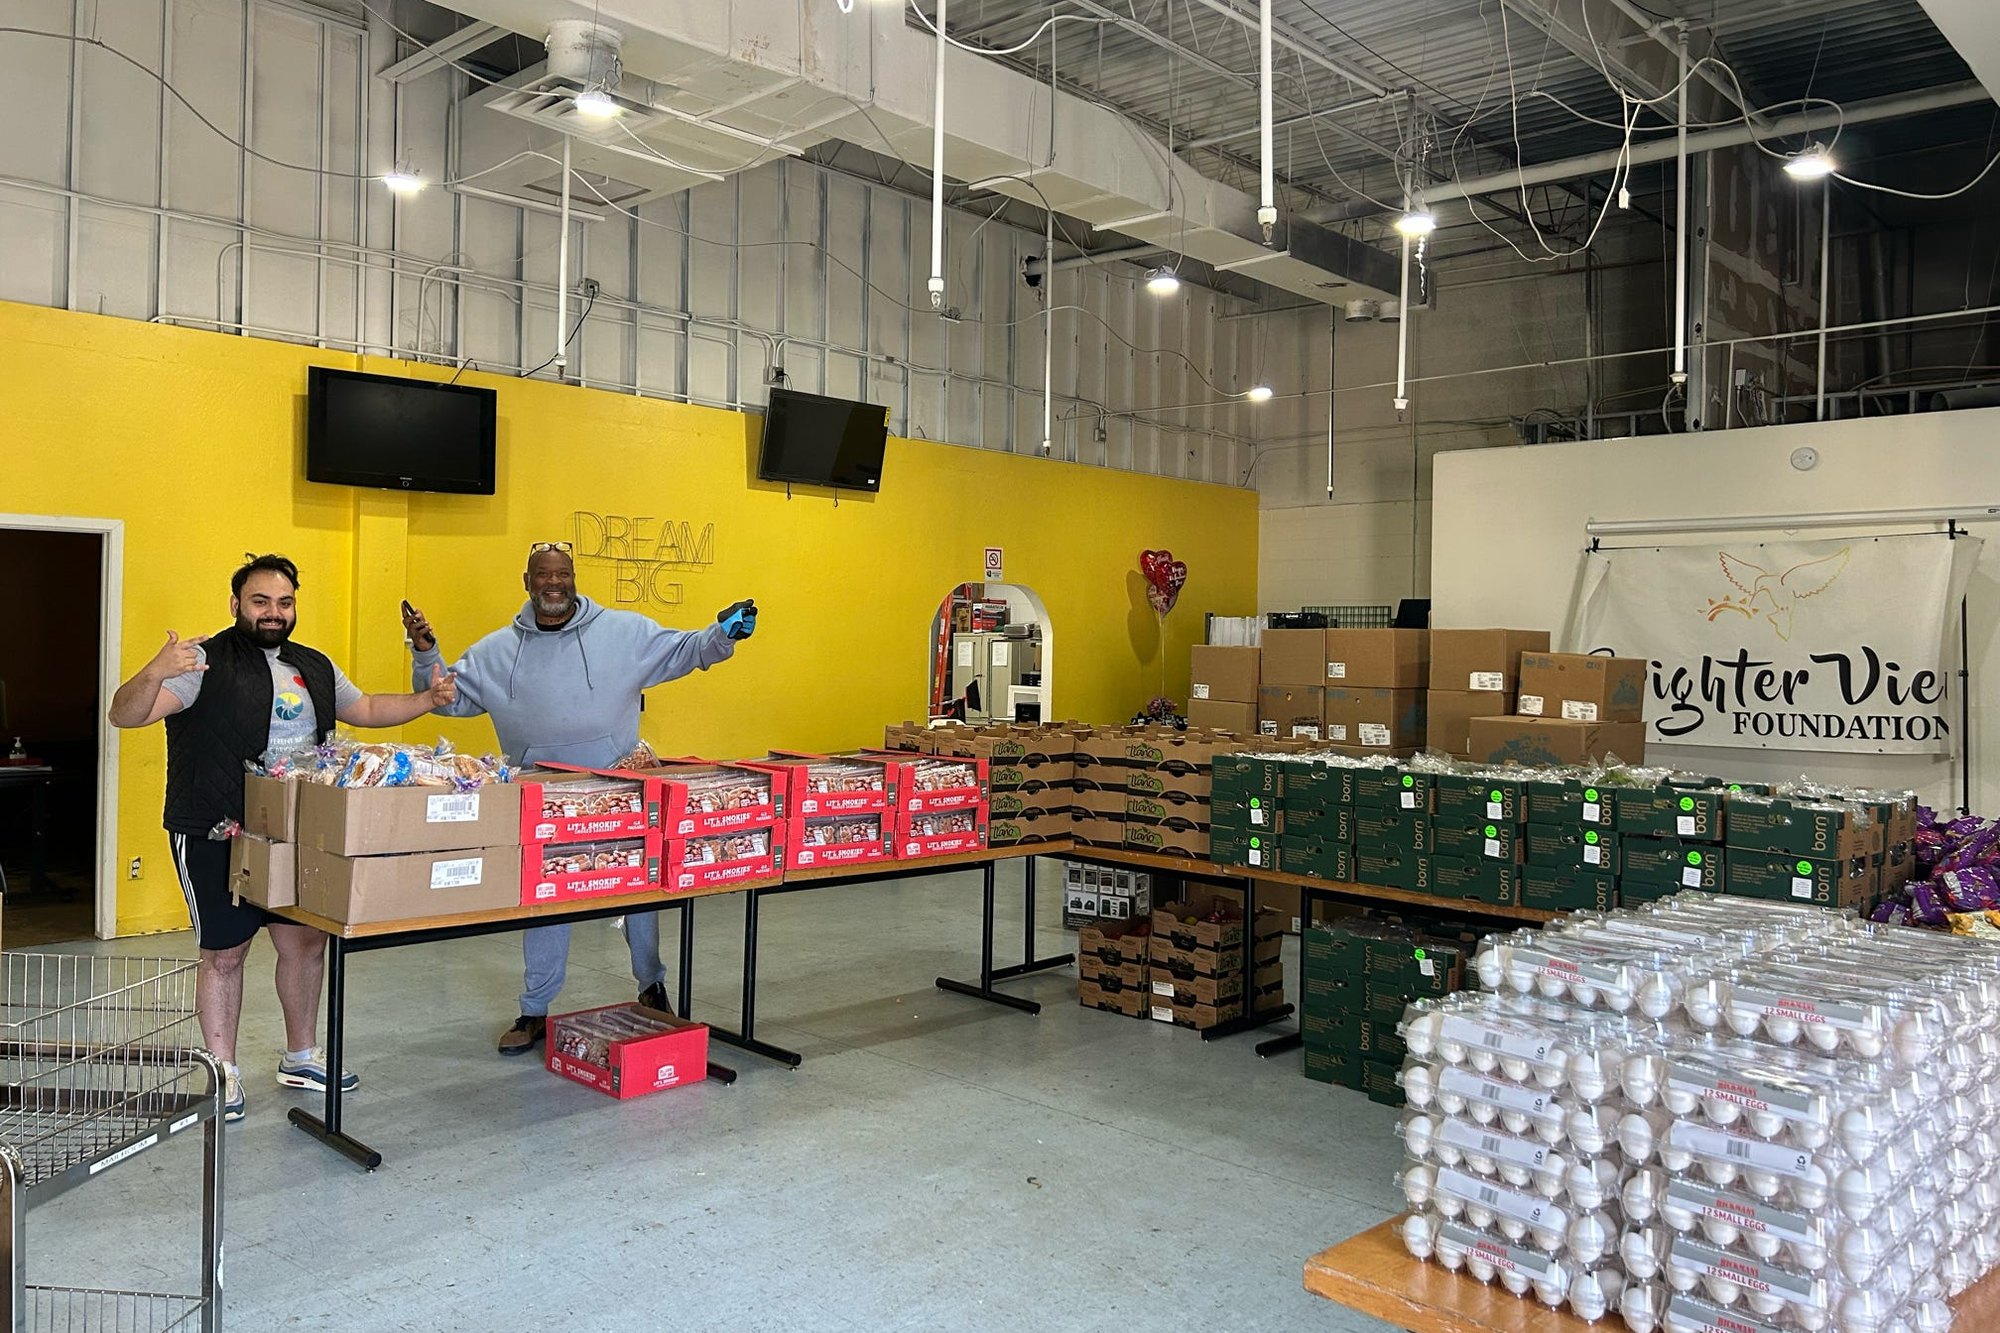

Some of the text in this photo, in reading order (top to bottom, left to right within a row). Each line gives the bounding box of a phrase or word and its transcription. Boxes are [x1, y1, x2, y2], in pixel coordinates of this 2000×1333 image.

[575, 511, 714, 564] DREAM
[616, 559, 683, 604] BIG
[1588, 646, 1948, 737] ighter Vie
[1263, 764, 1274, 791] born
[1341, 774, 1352, 802] born
[1502, 787, 1513, 818] born
[1600, 794, 1612, 826] born
[1695, 800, 1709, 834] born
[1337, 811, 1348, 840] born
[1413, 820, 1424, 850] born
[1811, 815, 1828, 851] born
[1261, 841, 1271, 868] born
[1499, 829, 1510, 859] born
[1599, 837, 1612, 869] born
[1336, 851, 1347, 879] born
[1416, 858, 1428, 888] born
[1702, 853, 1718, 887] born
[1498, 869, 1510, 901] born
[1815, 867, 1831, 902] born
[1431, 960, 1443, 990] born
[1538, 966, 1586, 984] 12 SMALL EGGS
[1765, 1006, 1826, 1024] 12 SMALL EGGS
[1359, 1022, 1371, 1052] born
[1703, 1088, 1769, 1111] 12 SMALL EGGS
[1702, 1206, 1767, 1232] 12 SMALL EGGS
[1466, 1246, 1516, 1271] 12 SMALL EGGS
[1706, 1265, 1770, 1292] 12 SMALL EGGS
